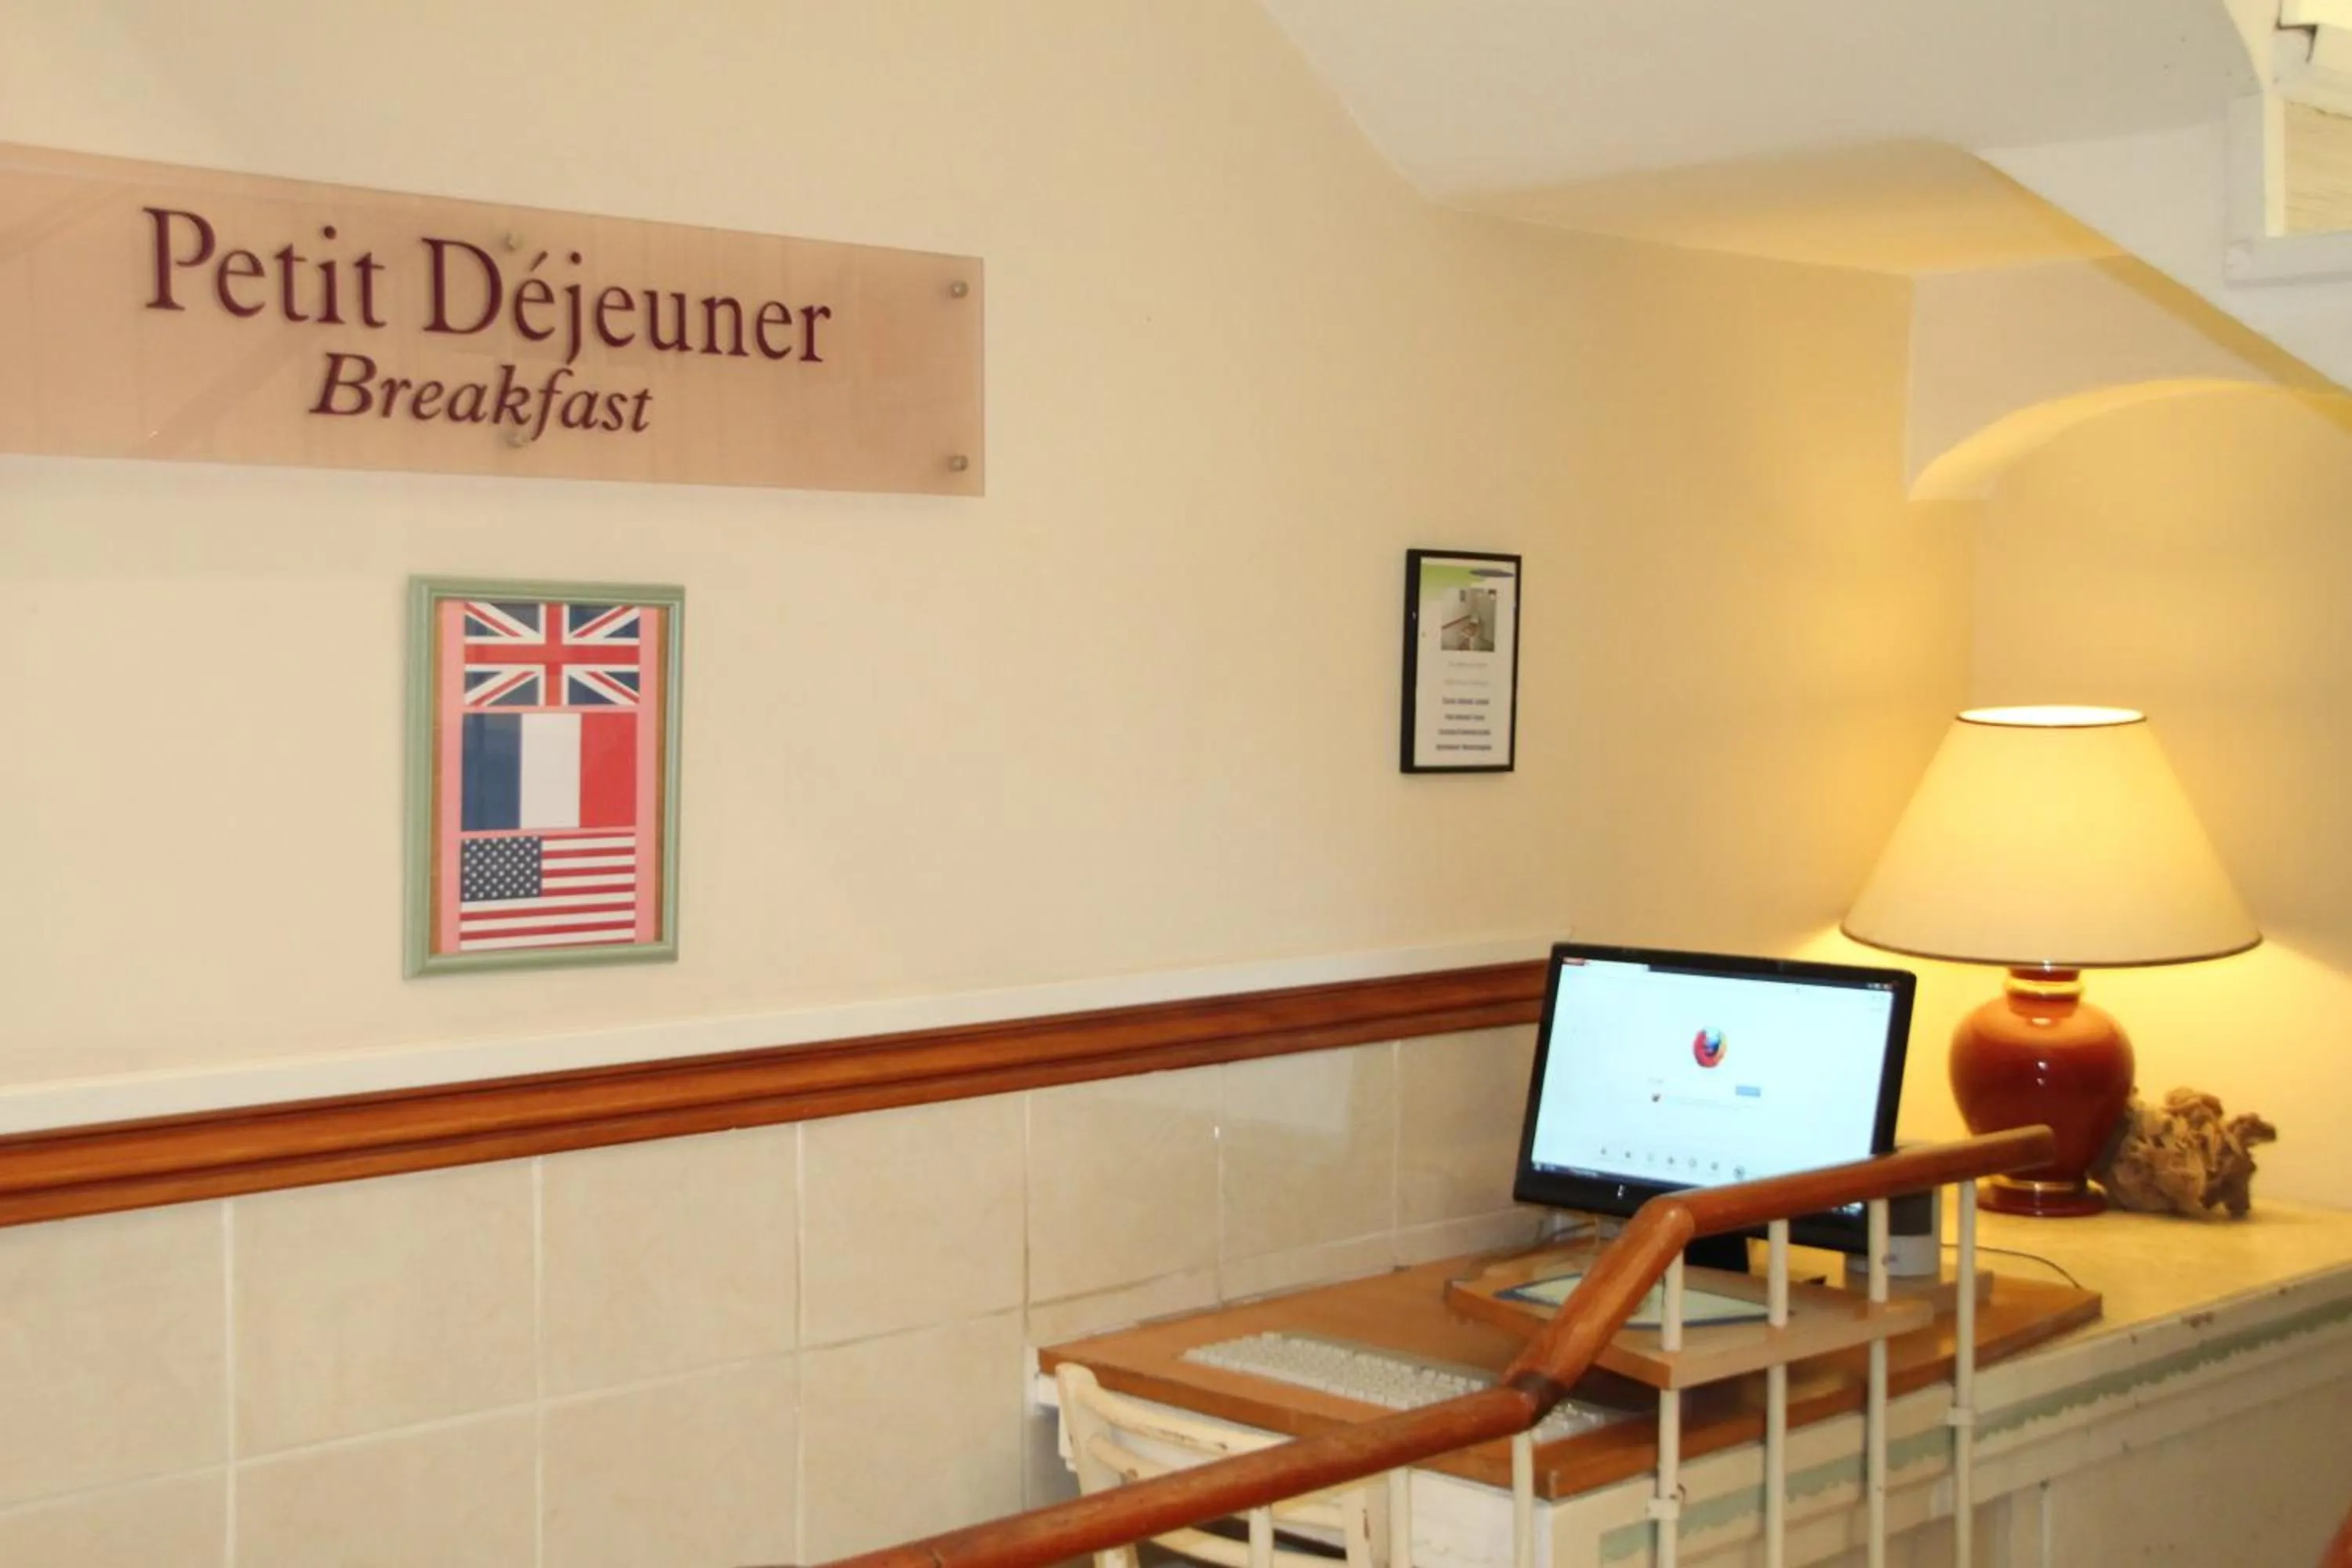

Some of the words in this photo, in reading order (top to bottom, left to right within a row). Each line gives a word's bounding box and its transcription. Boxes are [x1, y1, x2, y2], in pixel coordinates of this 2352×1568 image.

[142, 206, 387, 330] Petit
[419, 236, 833, 367] Déjeuner
[307, 351, 654, 443] Breakfast
